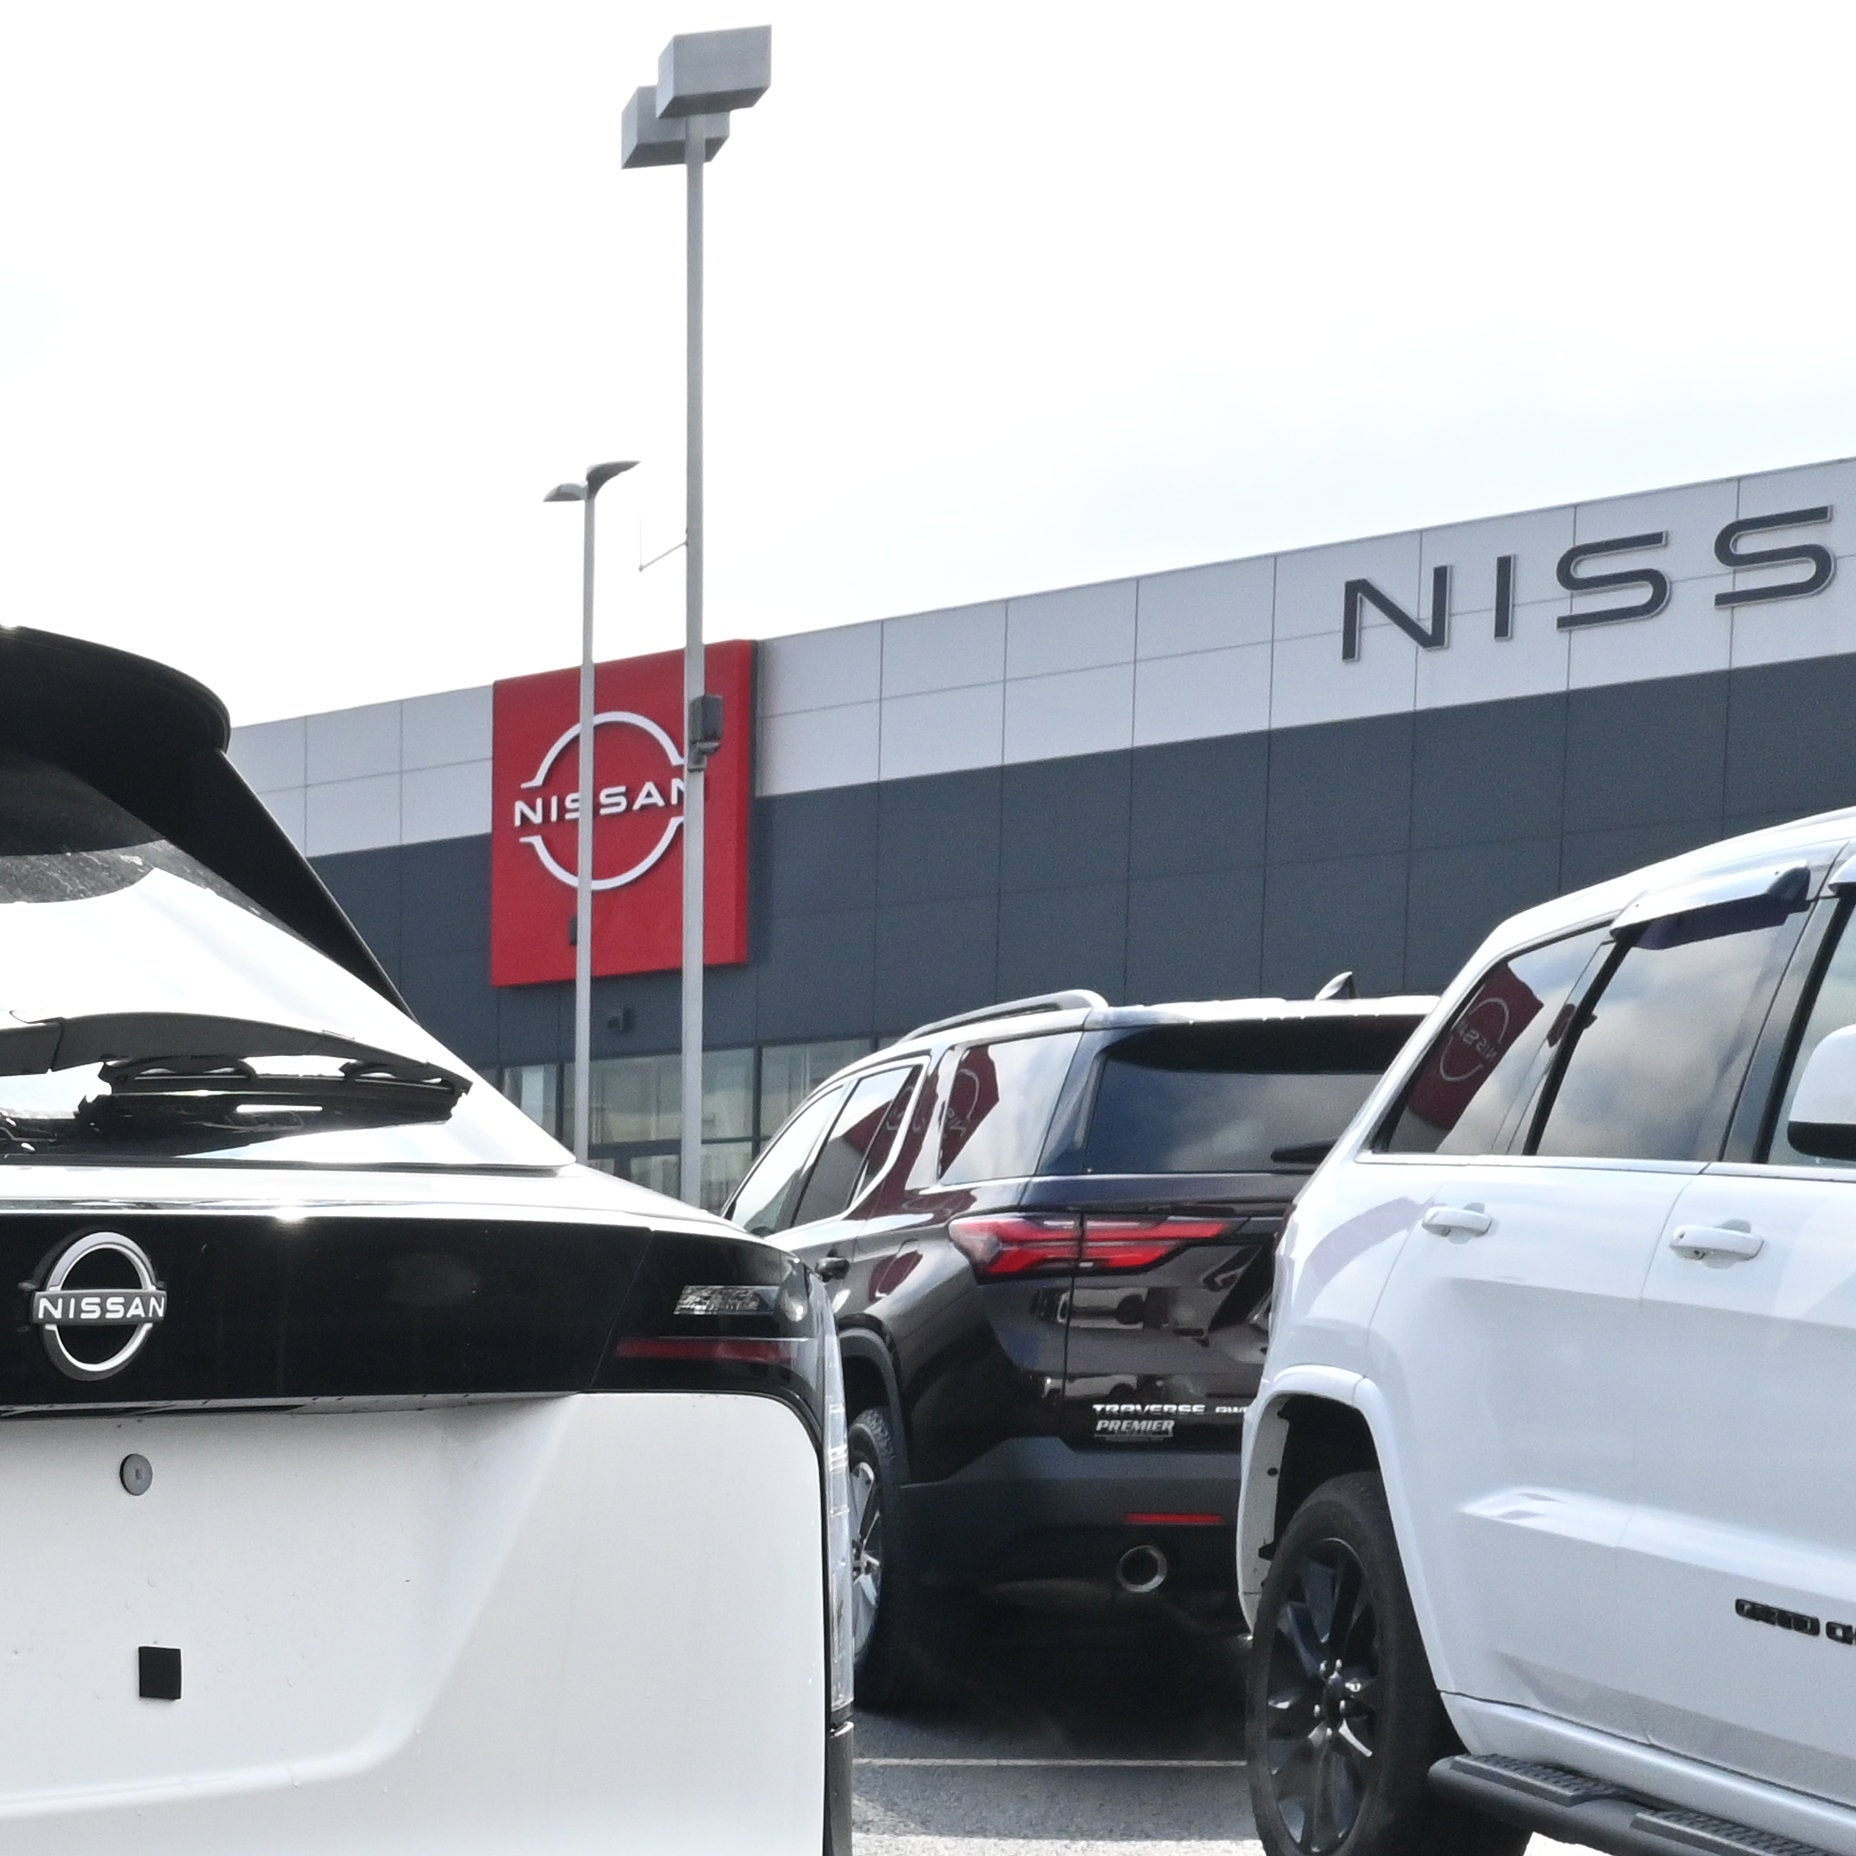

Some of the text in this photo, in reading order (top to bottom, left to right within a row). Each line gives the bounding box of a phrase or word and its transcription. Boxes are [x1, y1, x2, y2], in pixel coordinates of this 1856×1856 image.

[37, 1296, 166, 1320] NISSAN
[1092, 1403, 1206, 1416] TRAVERSE
[1096, 1419, 1176, 1433] PREMIER
